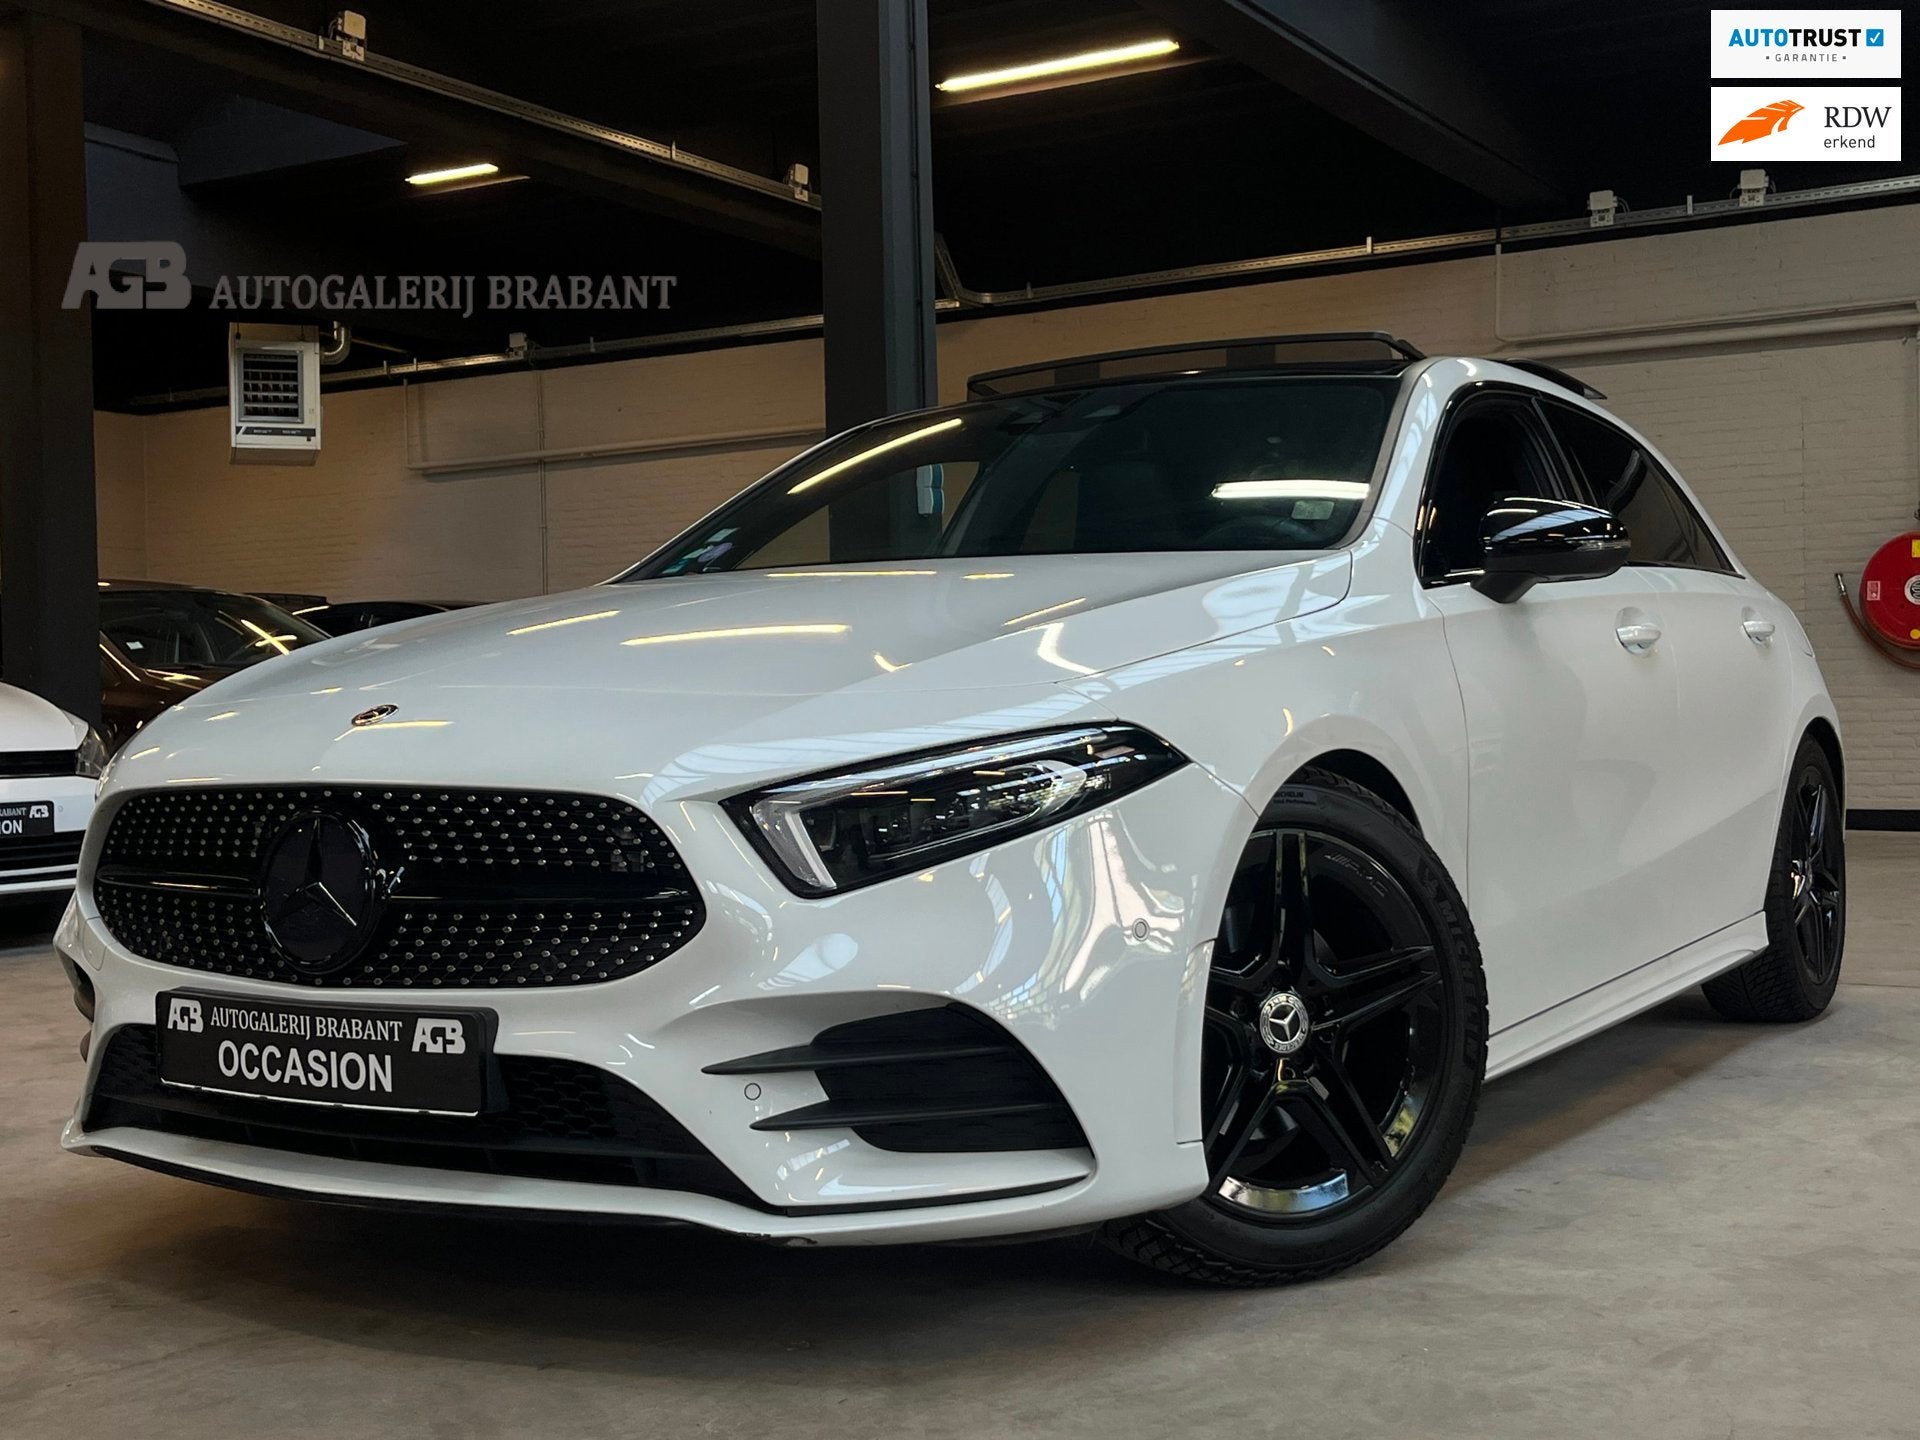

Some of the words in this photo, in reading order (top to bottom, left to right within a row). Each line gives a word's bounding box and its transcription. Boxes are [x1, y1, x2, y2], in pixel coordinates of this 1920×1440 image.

[29, 804, 50, 819] AGB
[1437, 897, 1481, 1065] MICHELIN
[167, 997, 204, 1033] AGB
[210, 1006, 312, 1042] AUTOGALERIJ
[315, 1016, 403, 1042] BRABANT
[411, 1017, 466, 1054] AGB
[218, 1039, 393, 1092] OCCASION
